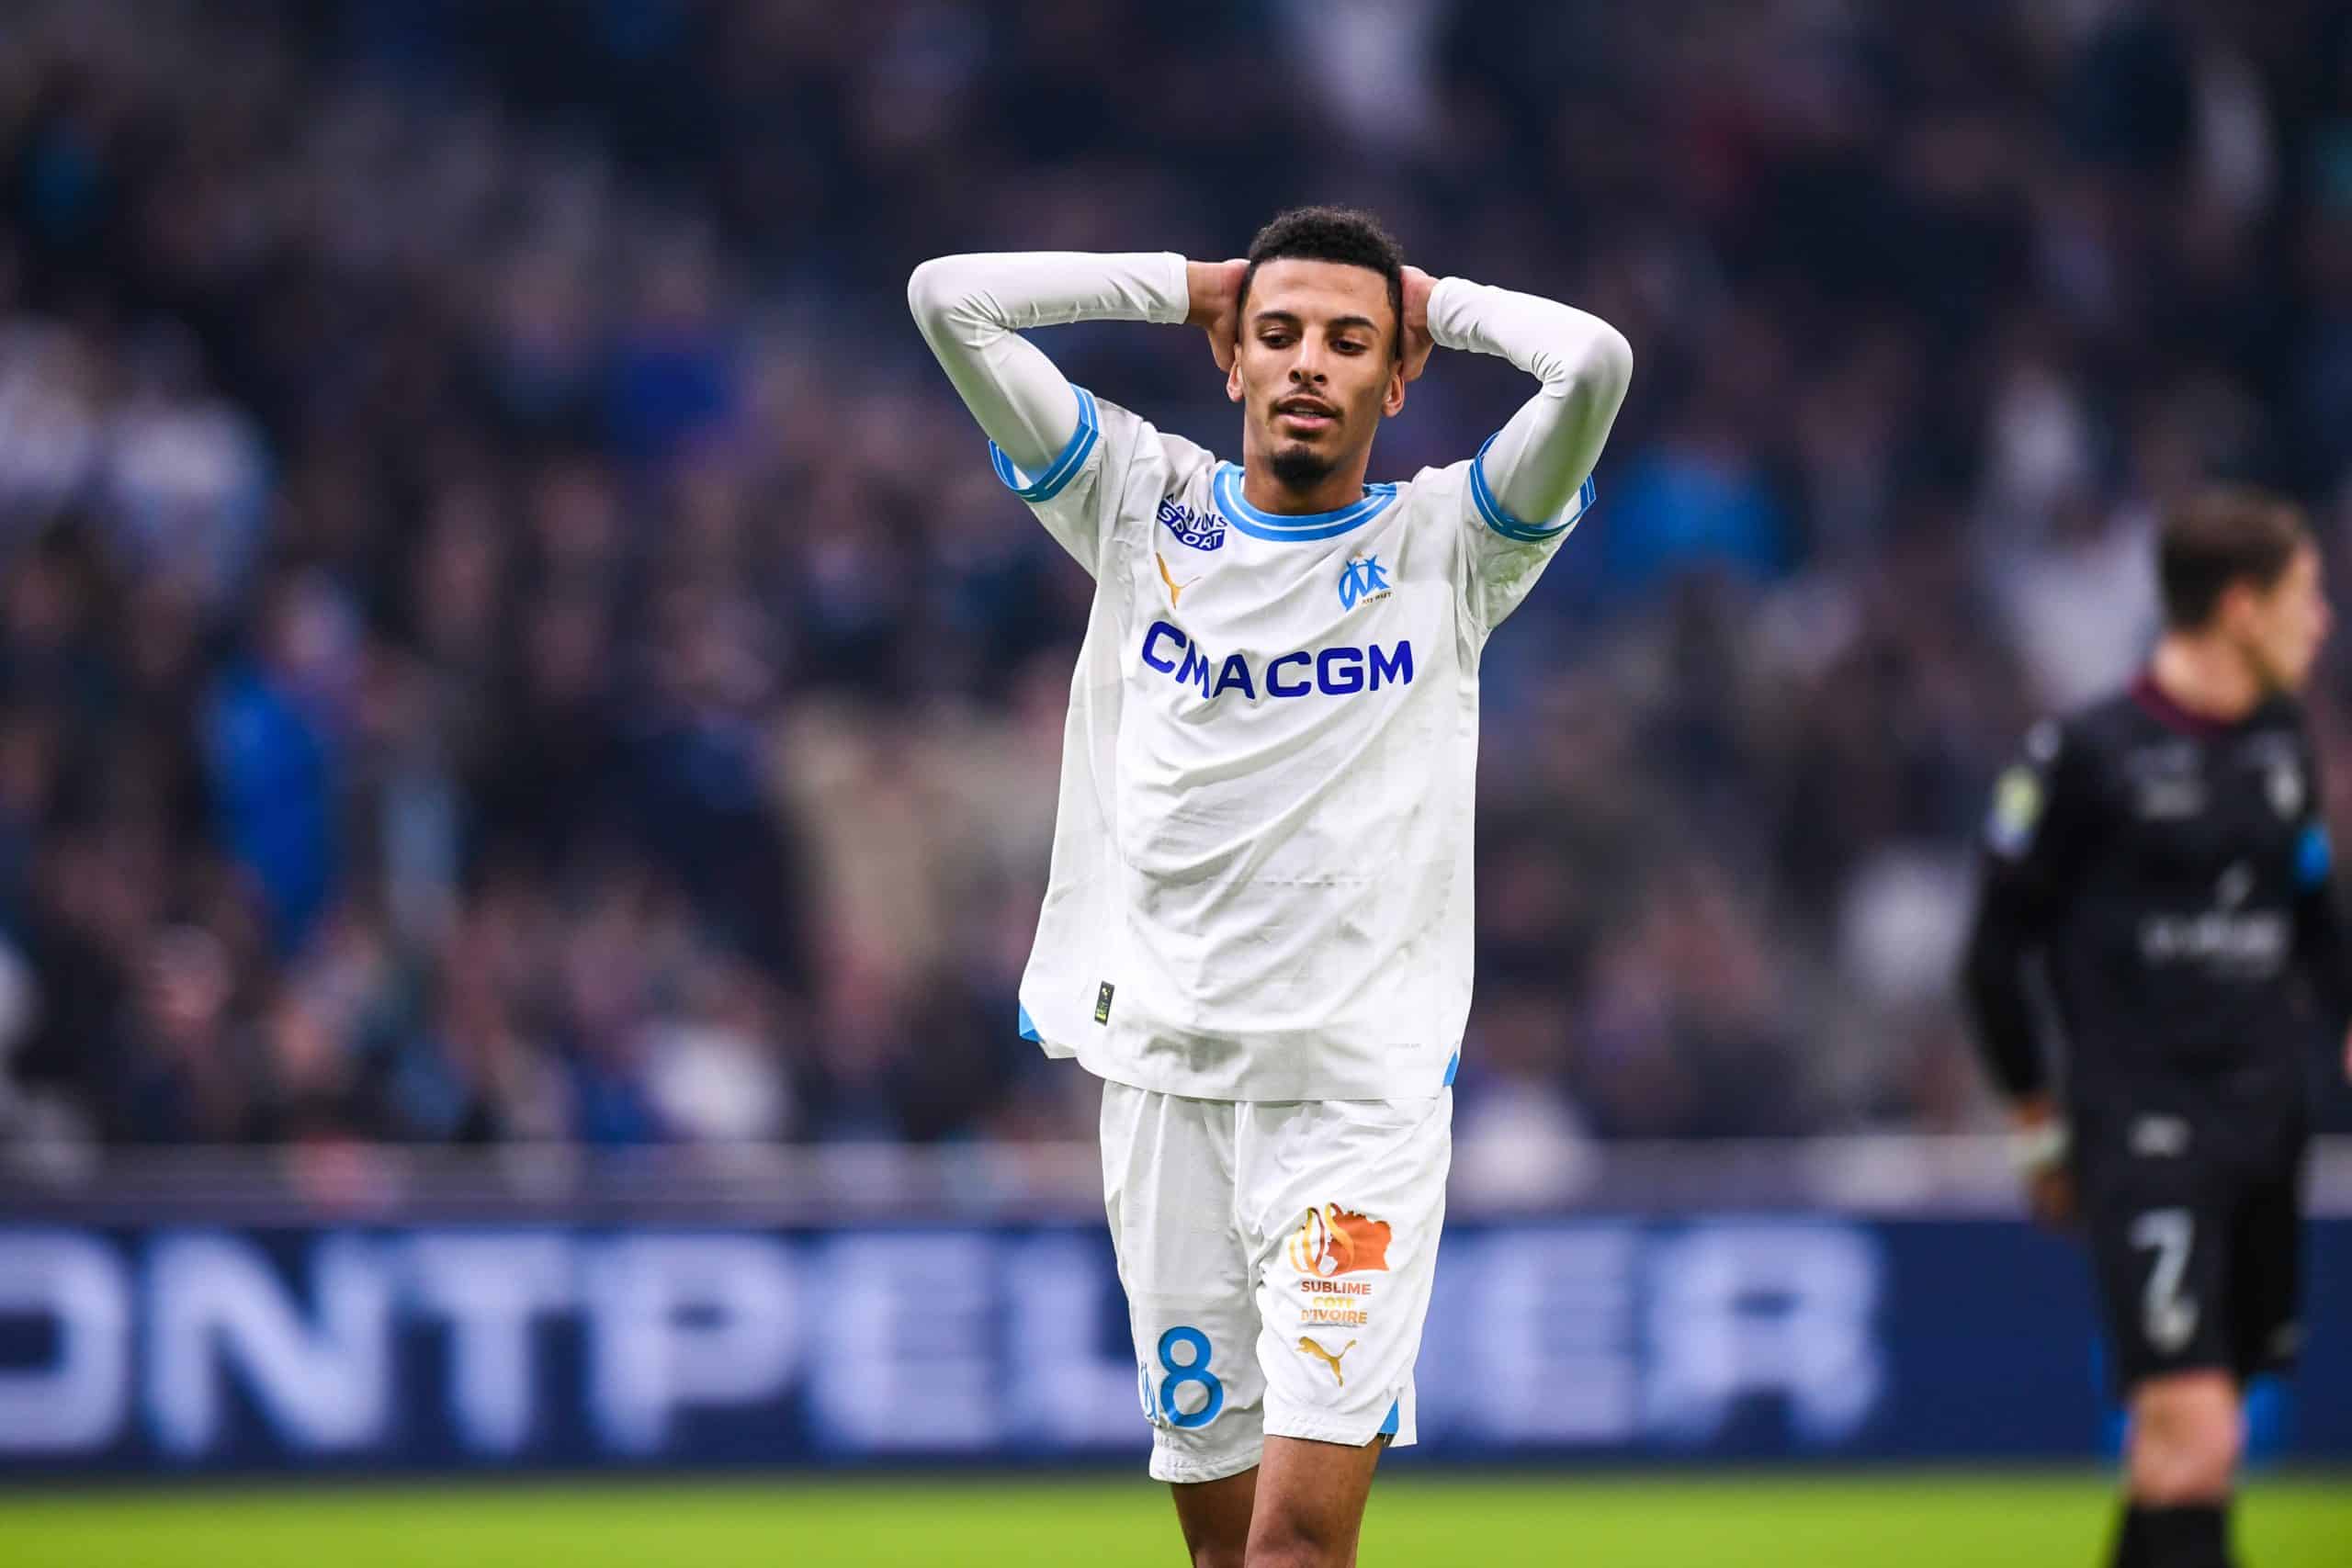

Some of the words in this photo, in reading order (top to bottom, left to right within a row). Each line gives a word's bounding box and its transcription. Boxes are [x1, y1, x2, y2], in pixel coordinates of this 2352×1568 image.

[1160, 506, 1224, 549] SPORT
[1301, 1280, 1373, 1295] SUBLIME
[1158, 1325, 1224, 1427] 8
